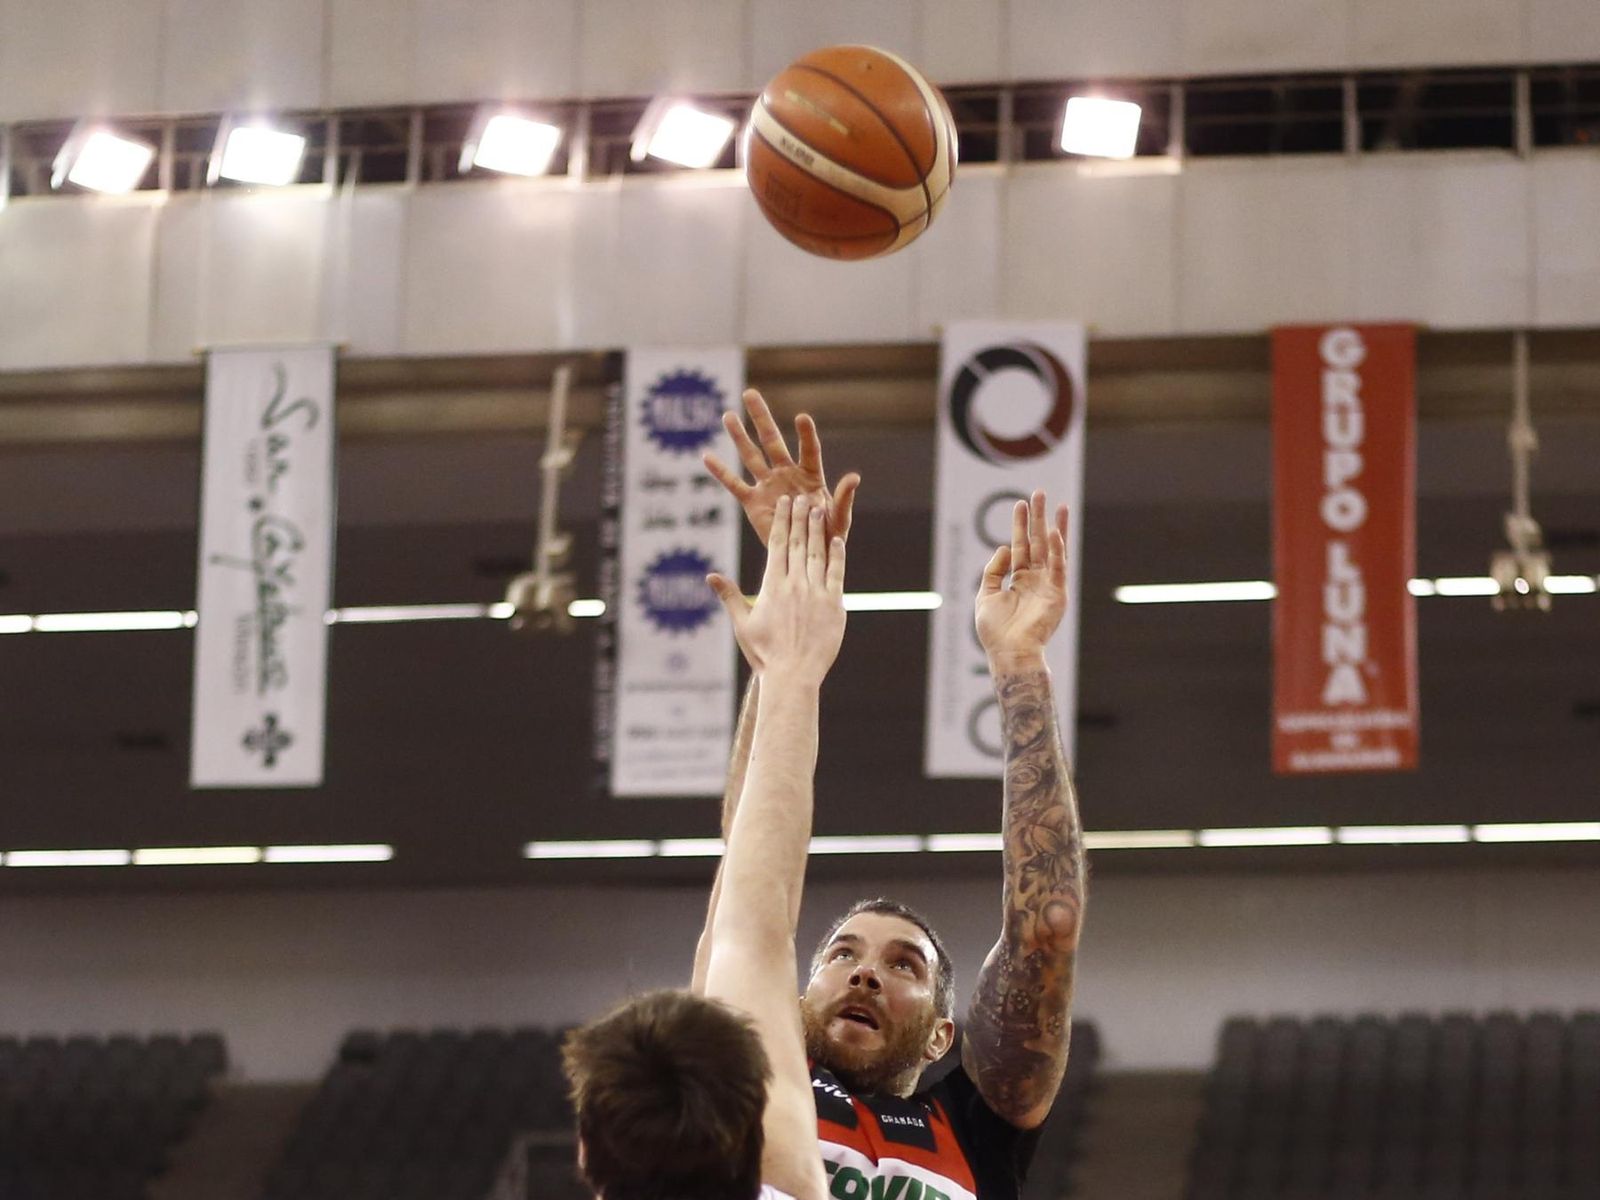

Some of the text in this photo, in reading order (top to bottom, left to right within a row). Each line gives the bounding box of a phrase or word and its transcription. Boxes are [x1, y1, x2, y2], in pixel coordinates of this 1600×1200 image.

[1319, 328, 1368, 533] GRUPO
[1320, 541, 1369, 704] LUNA
[881, 1114, 926, 1129] GRANADA
